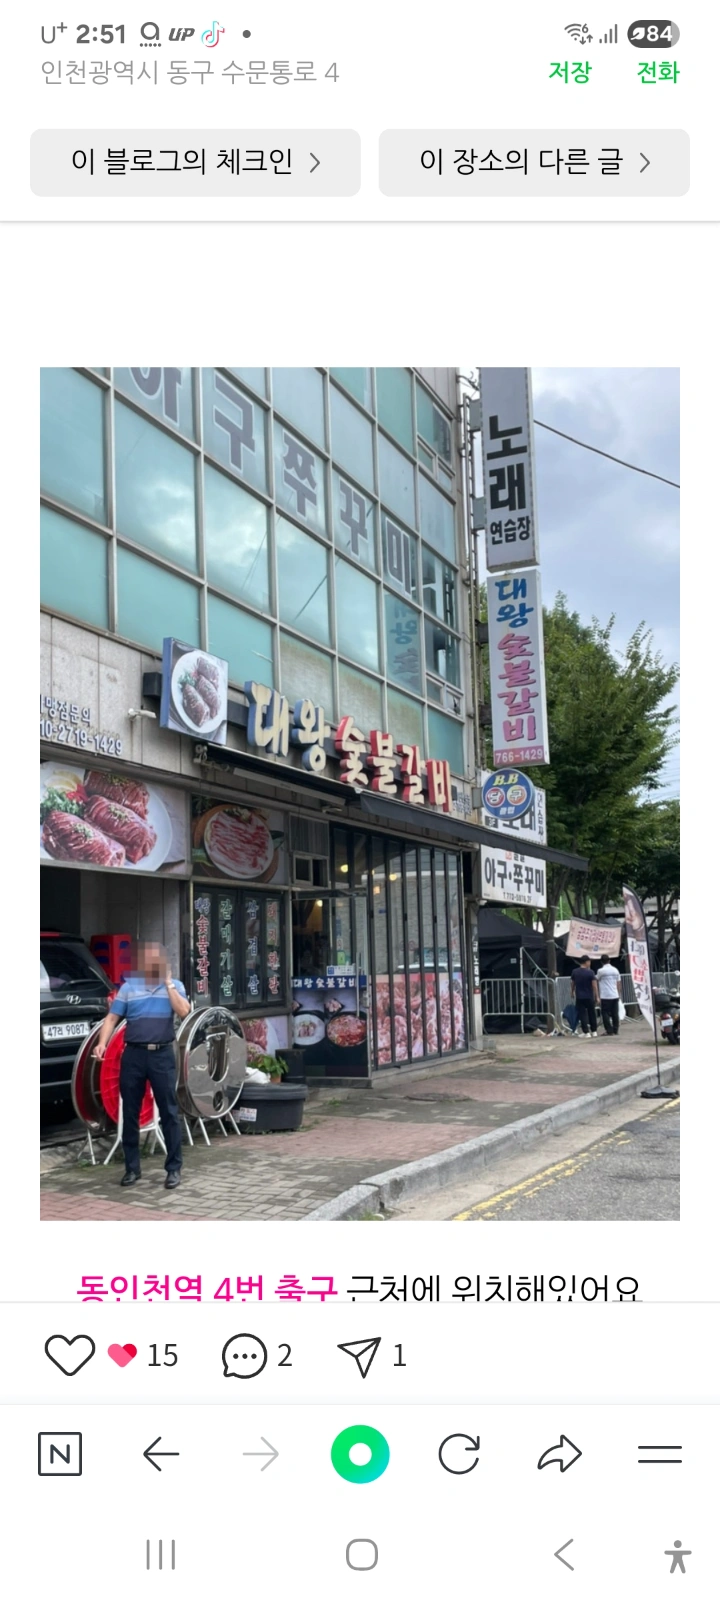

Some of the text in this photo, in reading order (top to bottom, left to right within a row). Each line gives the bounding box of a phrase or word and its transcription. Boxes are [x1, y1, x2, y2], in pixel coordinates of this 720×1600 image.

[42, 22, 67, 44] U+
[77, 24, 124, 44] 2:51
[646, 25, 673, 42] 84
[42, 61, 339, 84] 인천광역시 동구 수문통로 4
[549, 61, 592, 84] 저장
[637, 61, 680, 84] 전화
[73, 148, 291, 175] 이 블로그의 체크인
[421, 149, 623, 175] 이 장소의 다른 글
[487, 415, 527, 511] 노래
[490, 516, 531, 545] 연습장
[495, 578, 539, 742] 대왕 숯불갈비
[495, 749, 544, 764] 766-1429
[220, 899, 233, 997] 갈매기살
[246, 900, 259, 995] 삼겹살
[66, 1024, 84, 1036] 9087
[77, 1275, 201, 1302] 동인천역
[347, 1275, 439, 1302] 근처에
[148, 1344, 178, 1367] 15
[278, 1344, 292, 1367] 2
[393, 1344, 407, 1367] 1
